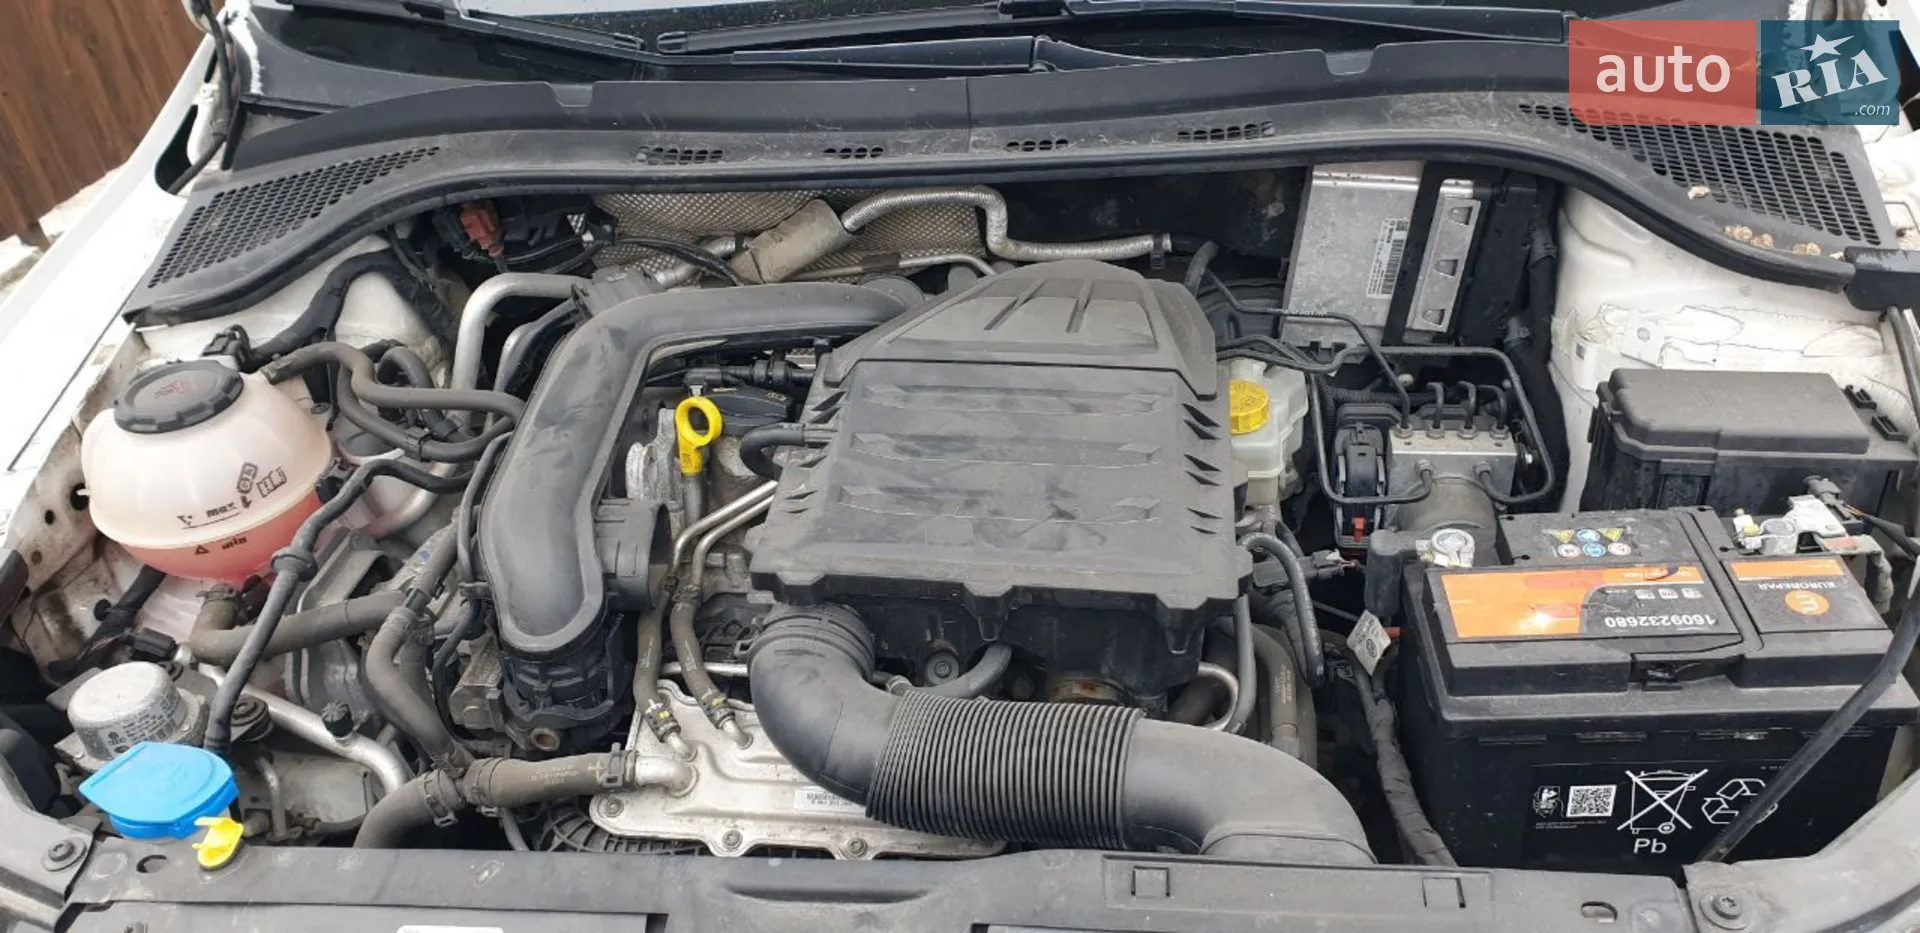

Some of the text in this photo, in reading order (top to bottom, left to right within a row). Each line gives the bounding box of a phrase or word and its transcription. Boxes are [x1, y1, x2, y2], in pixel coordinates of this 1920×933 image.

[205, 501, 237, 518] max
[1758, 580, 1837, 590] EUROREPAR
[1604, 614, 1717, 629] 1609232680
[1633, 838, 1667, 854] Pb
